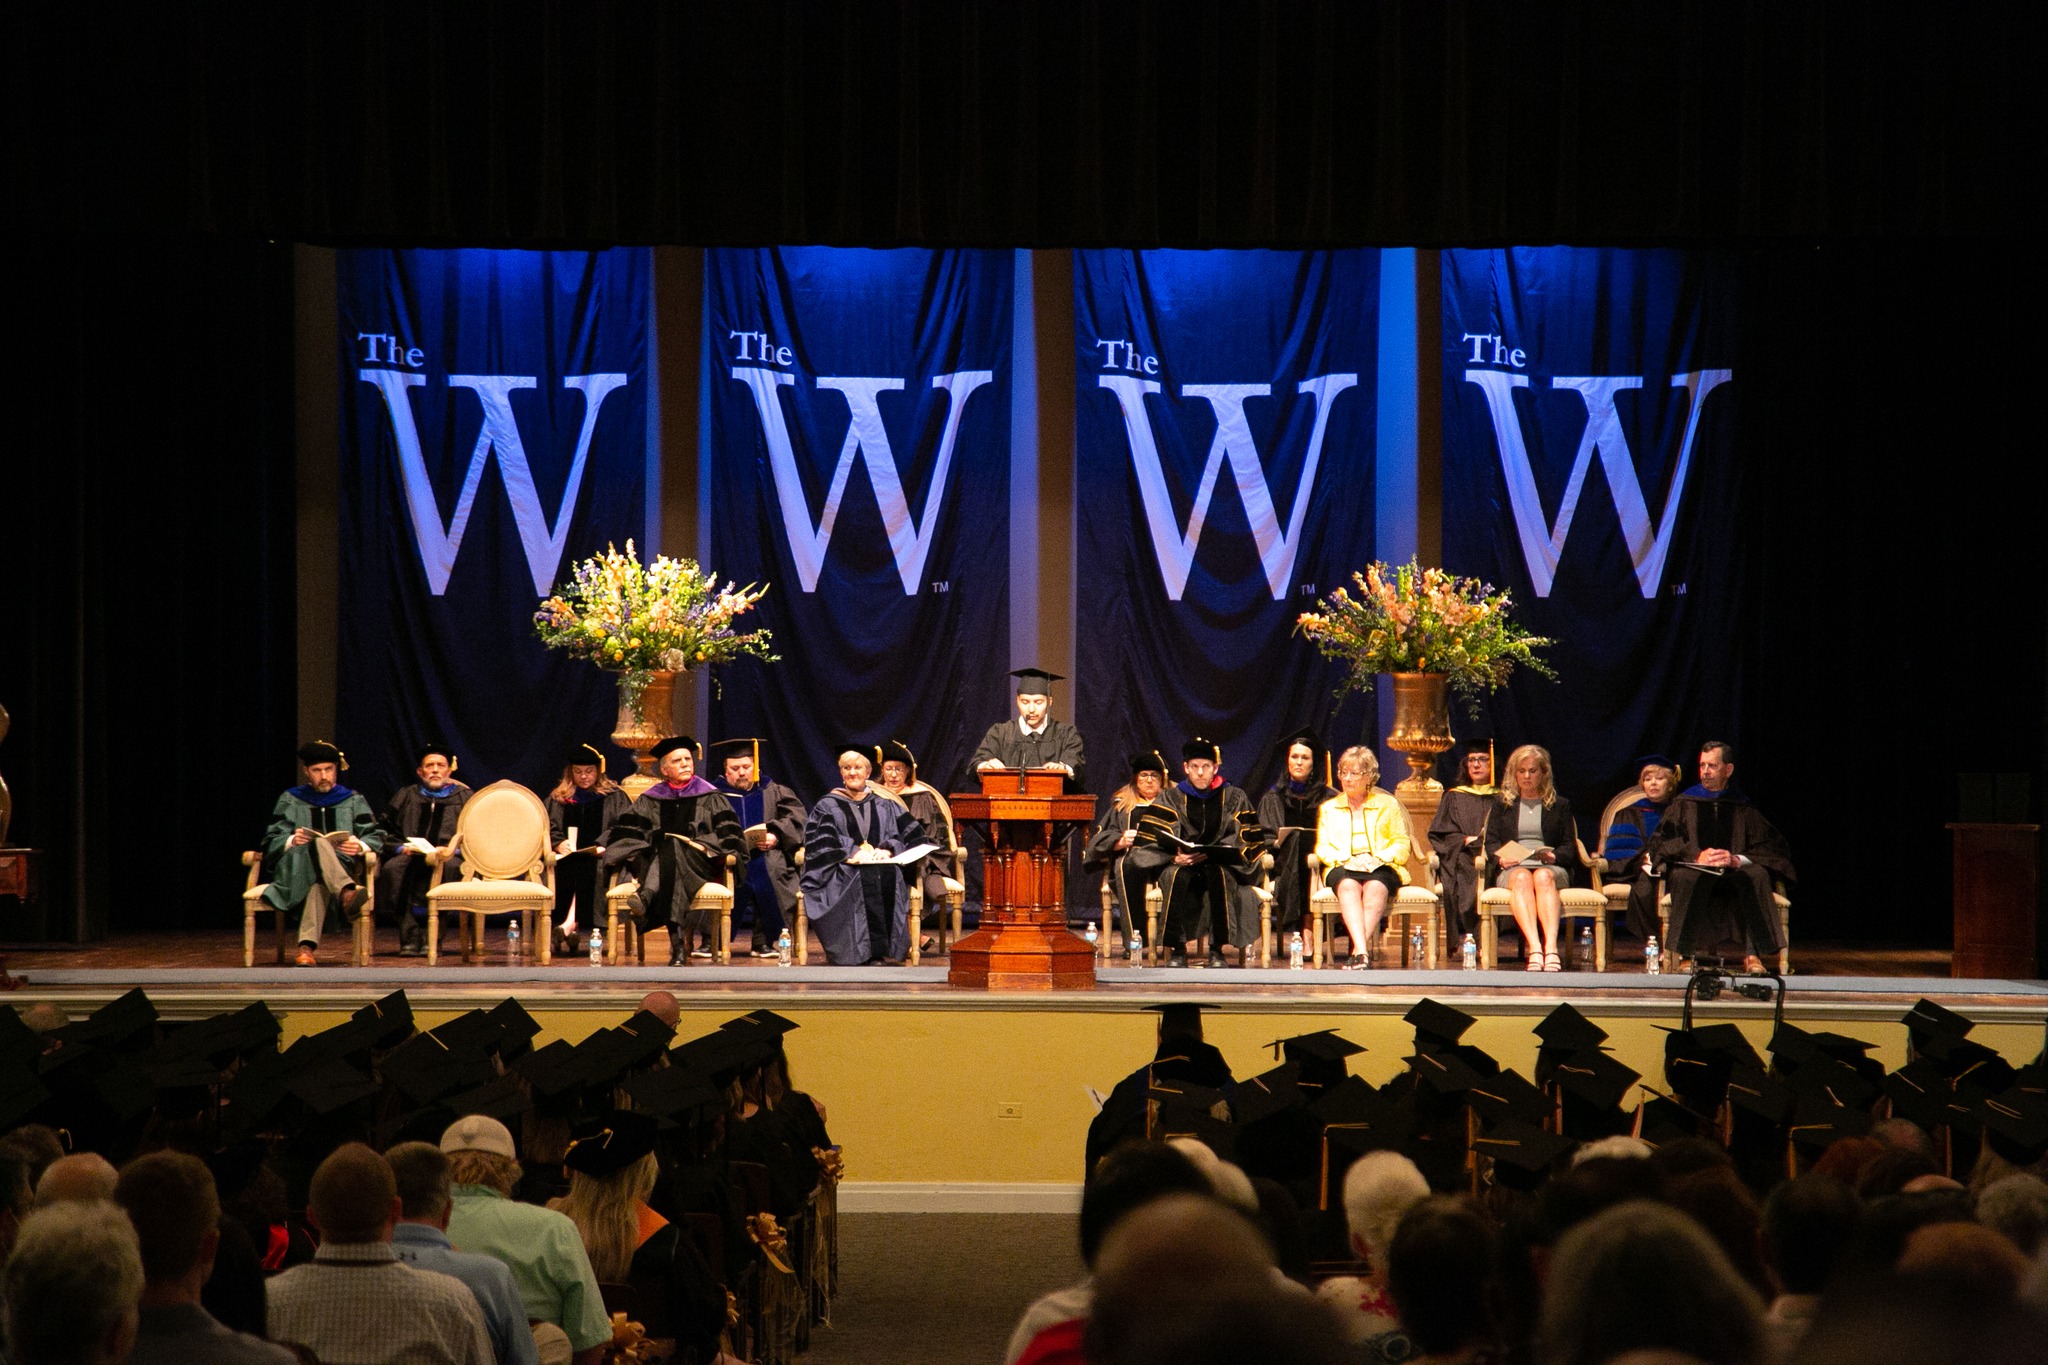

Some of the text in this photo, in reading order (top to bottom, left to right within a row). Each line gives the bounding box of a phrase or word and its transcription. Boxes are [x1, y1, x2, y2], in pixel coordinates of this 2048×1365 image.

[358, 331, 425, 367] The
[730, 330, 793, 366] The
[1097, 339, 1159, 374] The
[1463, 332, 1527, 368] The
[360, 369, 627, 597] W
[732, 367, 992, 596] W
[1098, 373, 1357, 600] W
[1465, 368, 1732, 598] W
